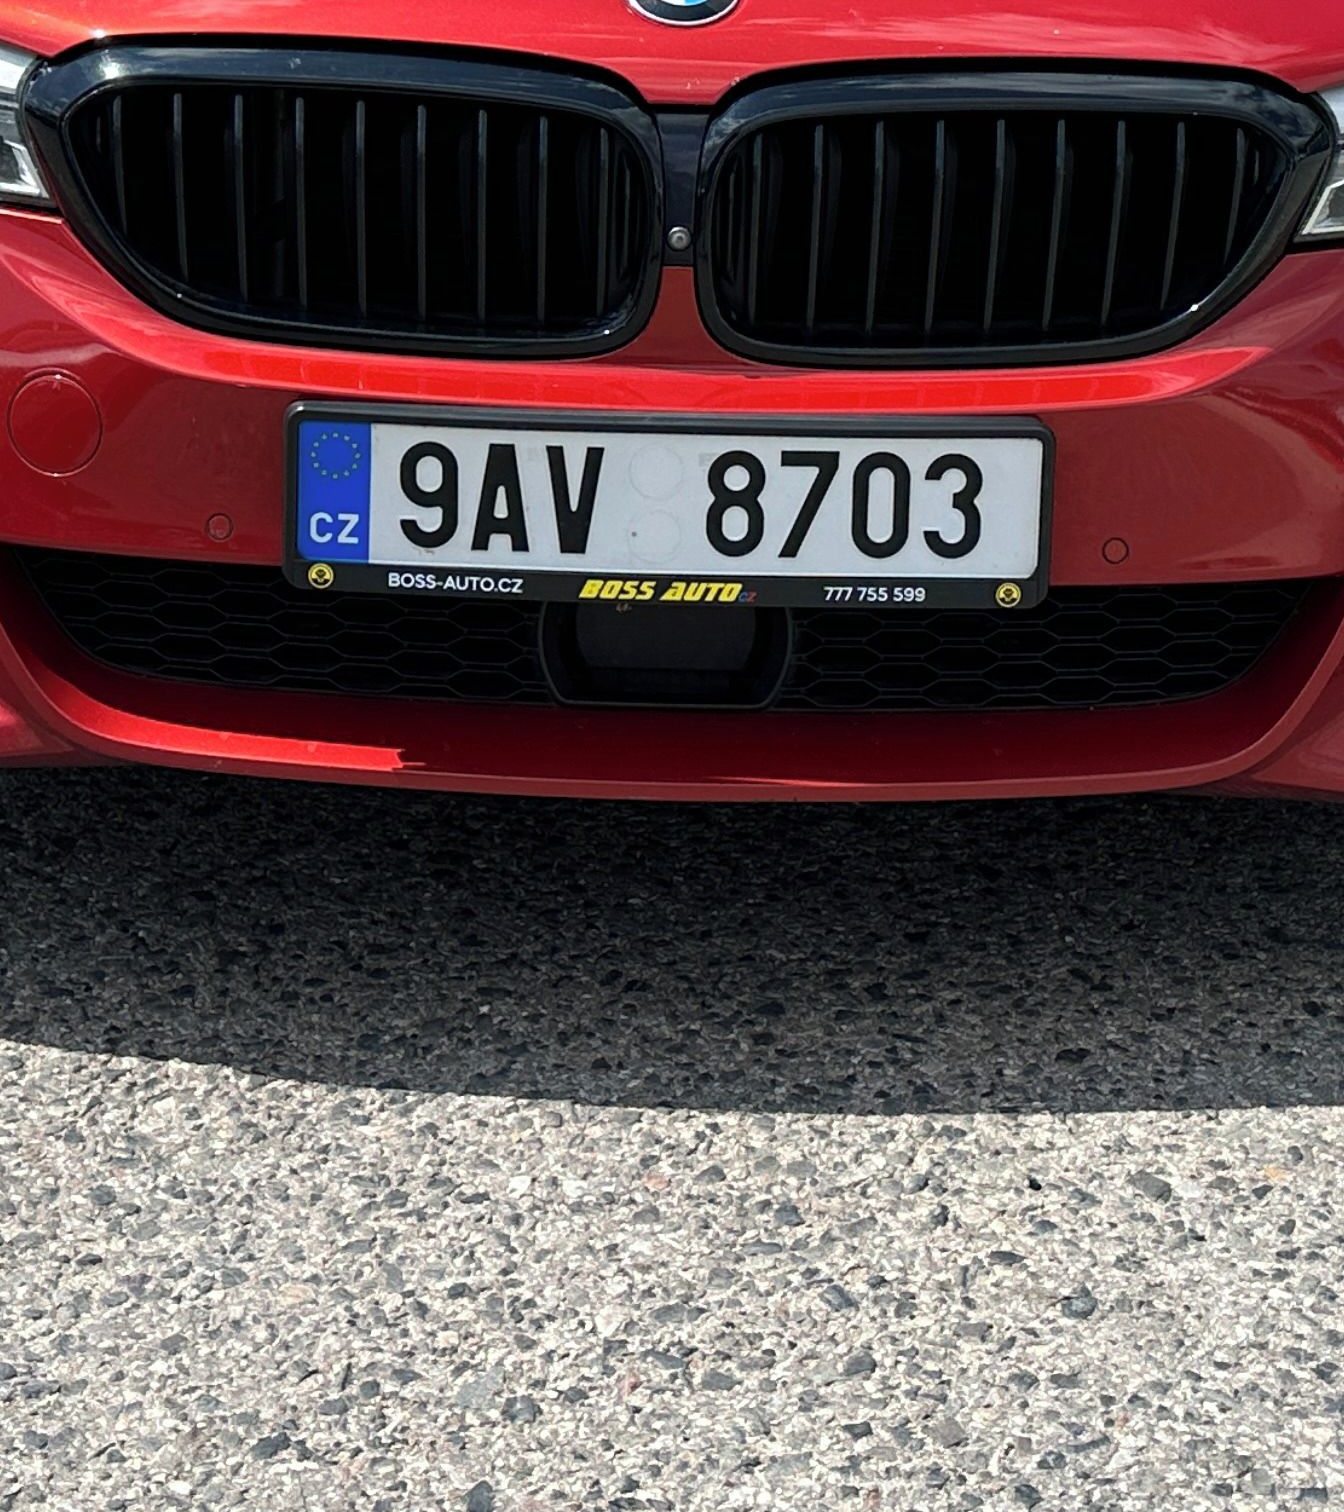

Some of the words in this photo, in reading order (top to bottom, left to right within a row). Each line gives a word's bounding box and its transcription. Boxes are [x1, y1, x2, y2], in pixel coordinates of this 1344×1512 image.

[399, 441, 605, 554] 9AV
[706, 450, 984, 559] 8703
[309, 511, 359, 544] CZ
[388, 572, 524, 594] BOSS-AUTO.CZ
[578, 579, 656, 601] BOSS
[823, 586, 853, 601] 777
[857, 587, 888, 602] 755
[893, 587, 926, 602] 599
